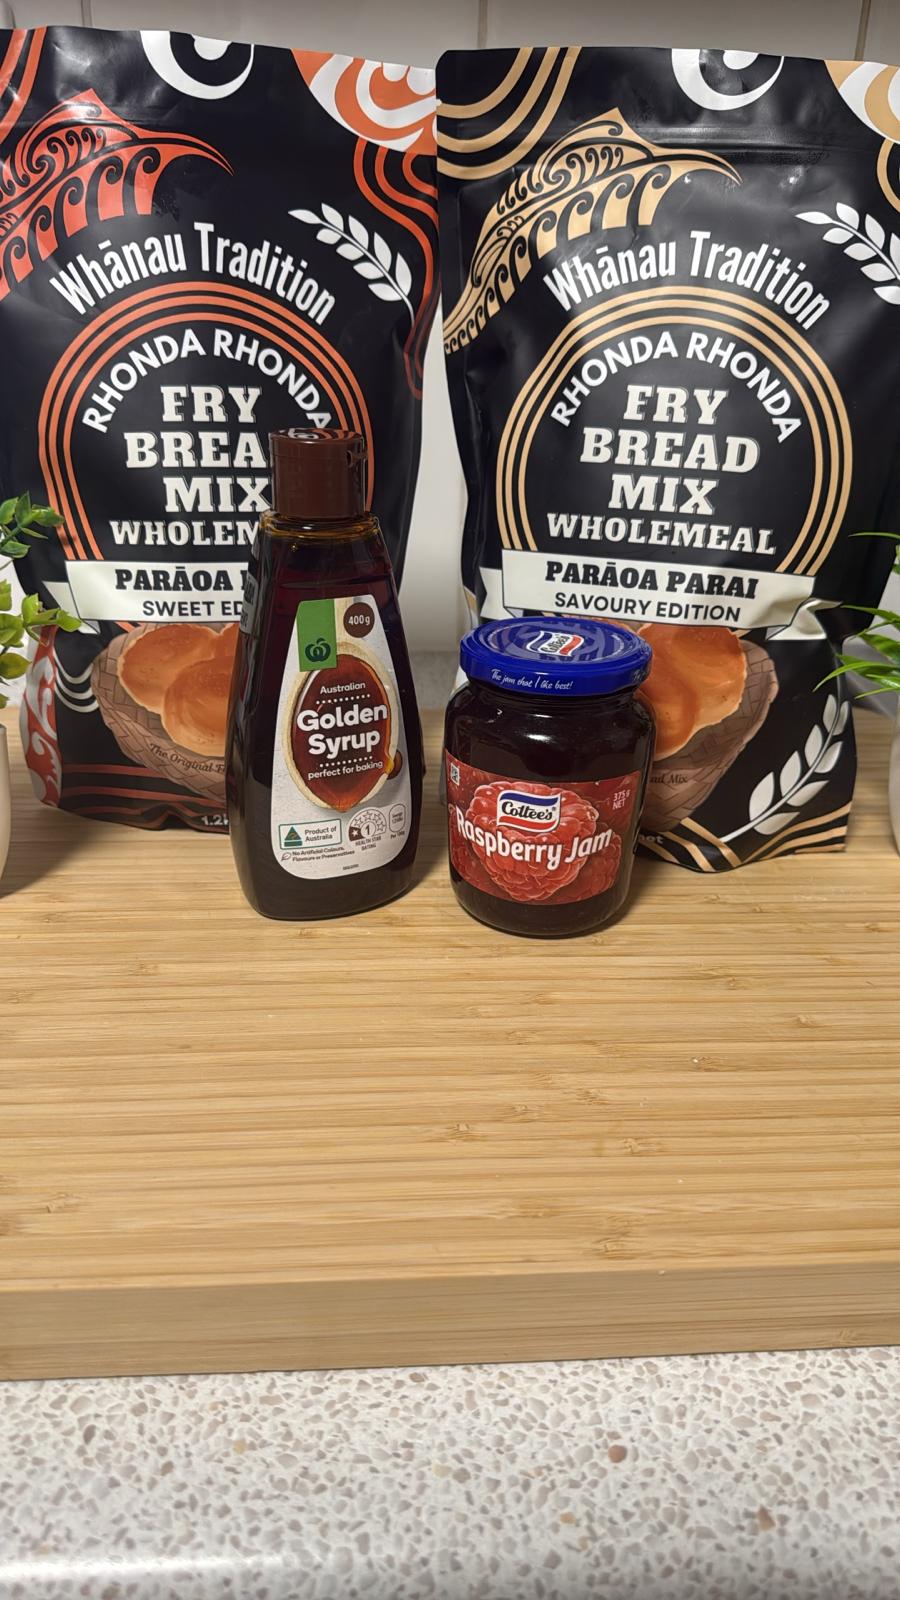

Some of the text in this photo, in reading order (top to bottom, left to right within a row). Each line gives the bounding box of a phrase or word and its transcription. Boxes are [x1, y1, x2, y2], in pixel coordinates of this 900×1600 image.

[49, 222, 335, 326] Whānau Tradition
[543, 230, 830, 331] Whānau Tradition
[82, 329, 332, 433] RHONDA RHONDA
[550, 331, 802, 443] RHONDA RHONDA
[160, 385, 262, 423] FRY
[623, 384, 729, 425] FRY
[124, 431, 269, 469] BREA
[580, 427, 760, 474] BREAD
[163, 477, 272, 513] MIX
[608, 473, 719, 516] MIX
[110, 520, 259, 546] WHOLEM
[546, 513, 777, 556] WHOLEMEAL
[115, 565, 233, 591] PARĀOA
[545, 561, 760, 600] PARĀOA PARAI
[142, 601, 214, 617] SWEET
[348, 613, 371, 626] 400g
[555, 592, 741, 622] SAVOURY EDITION
[320, 682, 366, 695] Australian
[491, 668, 501, 680] The
[501, 674, 516, 685] jam
[517, 676, 533, 688] that
[297, 704, 388, 732] Golden
[150, 743, 168, 758] The
[170, 753, 212, 773] Original
[308, 730, 380, 759] Syrup
[308, 761, 384, 781] perfect for baking
[669, 774, 688, 784] Mix
[501, 801, 553, 821] Cottee's
[613, 798, 626, 810] NET
[305, 827, 330, 835] Product
[305, 834, 333, 842] Australia
[365, 824, 370, 835] 1
[456, 806, 613, 871] Raspberry Jam
